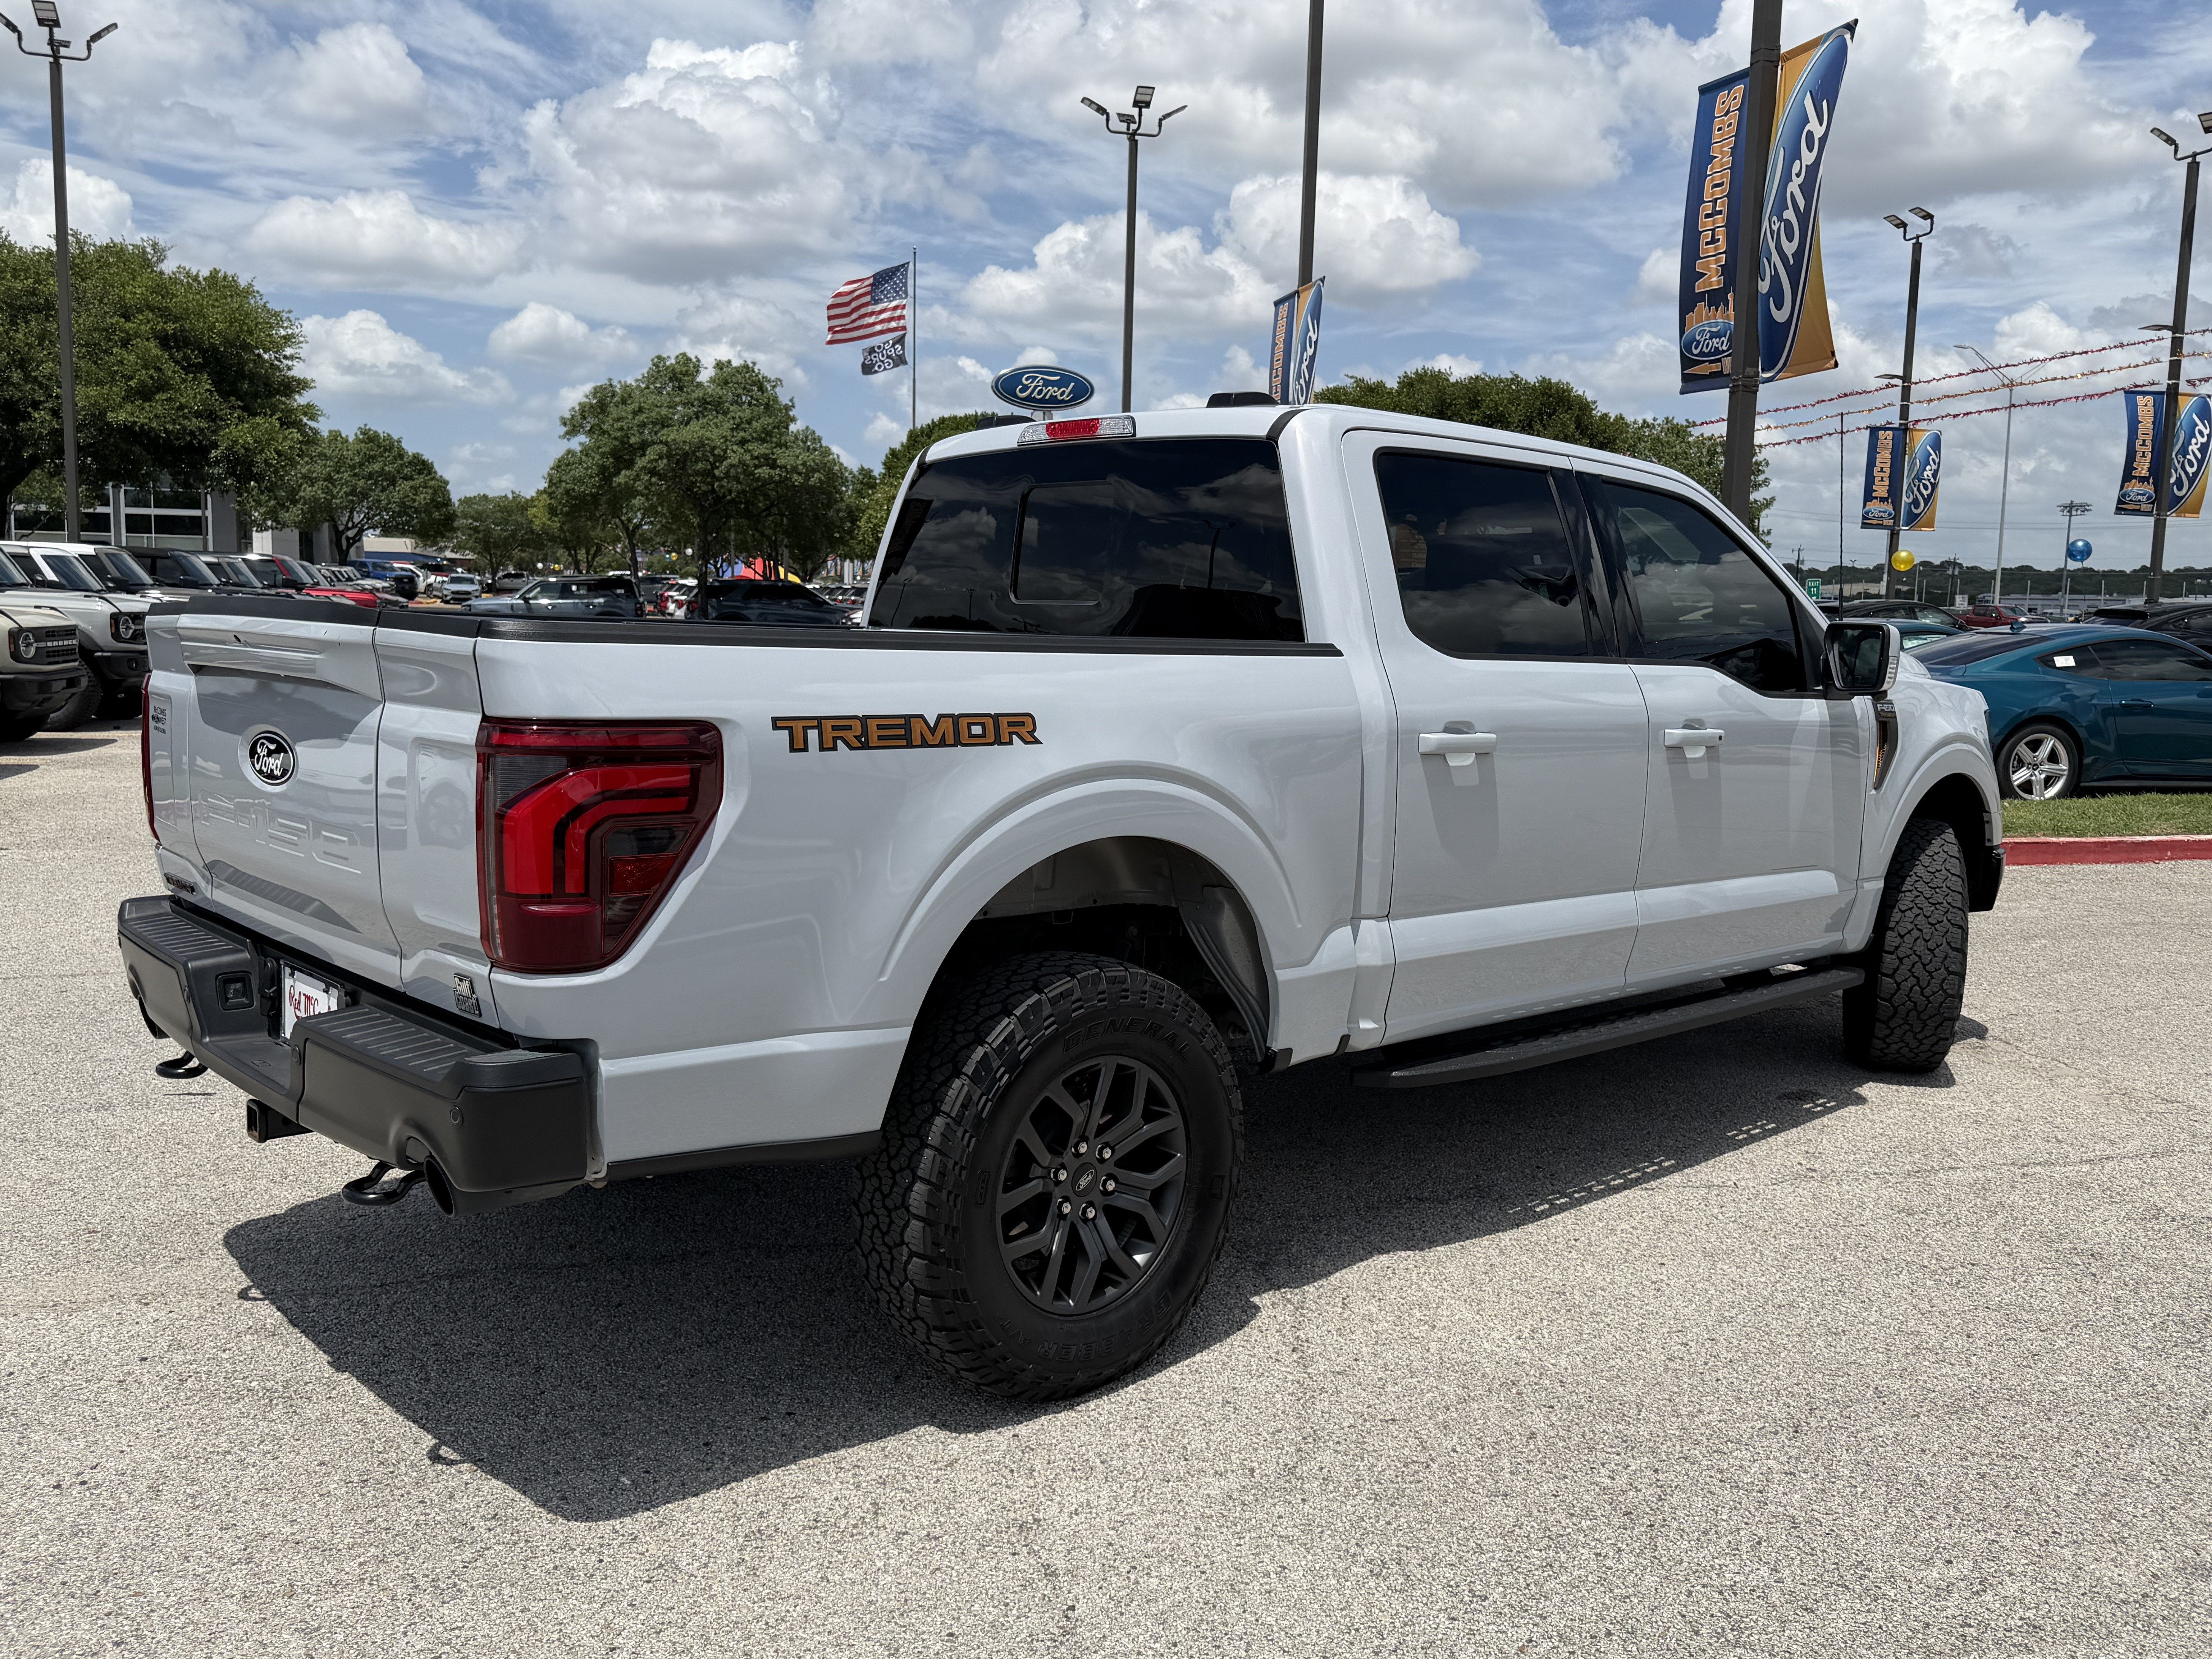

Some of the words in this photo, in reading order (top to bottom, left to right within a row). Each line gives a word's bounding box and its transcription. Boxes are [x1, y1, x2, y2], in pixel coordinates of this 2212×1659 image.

[1758, 89, 1828, 323] Ford
[1272, 302, 1289, 404] CCOMBS
[1692, 326, 1730, 355] Ford
[1016, 373, 1074, 400] Ford
[2170, 413, 2210, 496] Ford
[1904, 445, 1939, 514] Ford
[2126, 489, 2148, 501] Ford
[1869, 508, 1889, 517] Ford
[771, 712, 1043, 753] TREMOR
[254, 739, 284, 776] Ford
[1063, 1016, 1191, 1063] GENERAL
